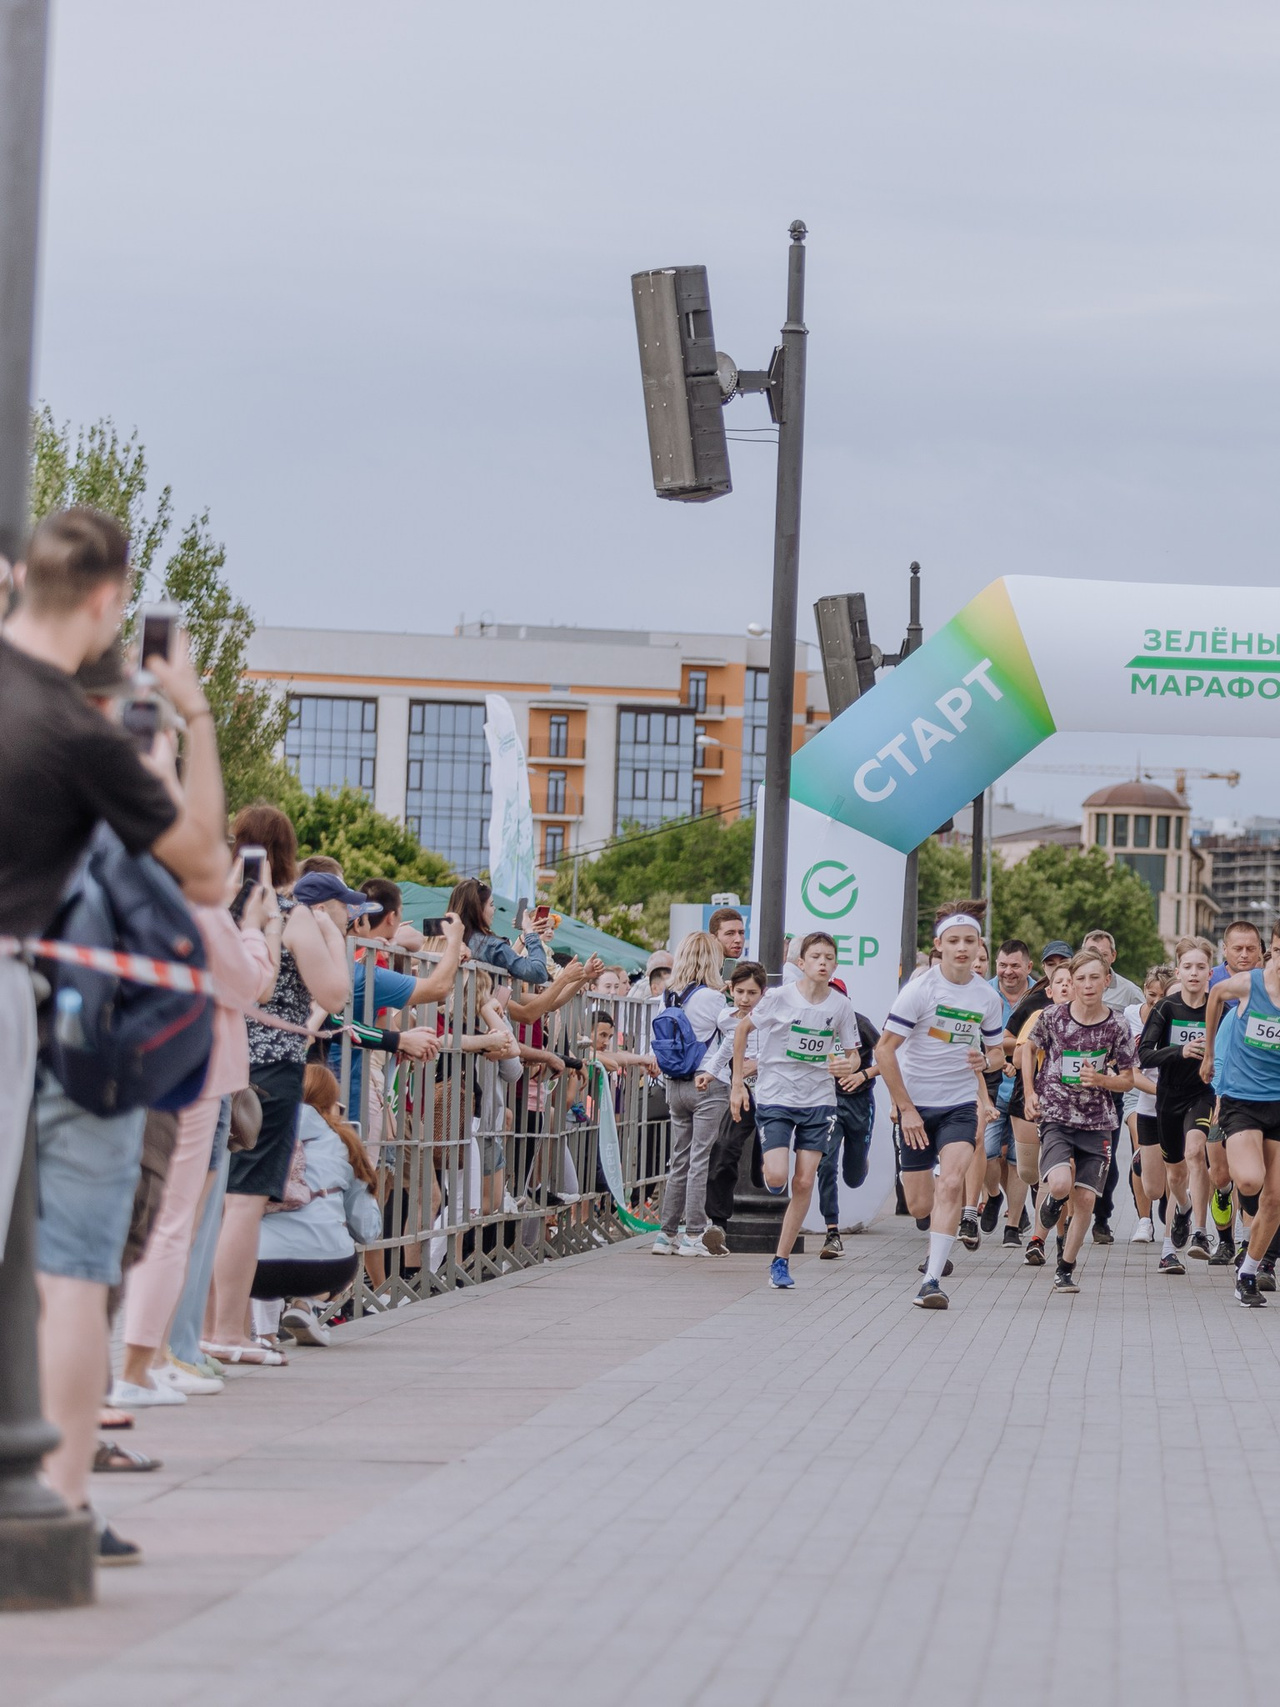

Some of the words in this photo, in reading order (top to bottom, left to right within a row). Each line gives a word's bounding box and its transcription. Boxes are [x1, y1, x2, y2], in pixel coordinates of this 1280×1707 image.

[853, 658, 1004, 803] СТАРТ
[954, 1022, 972, 1033] 012
[798, 1037, 825, 1052] 509
